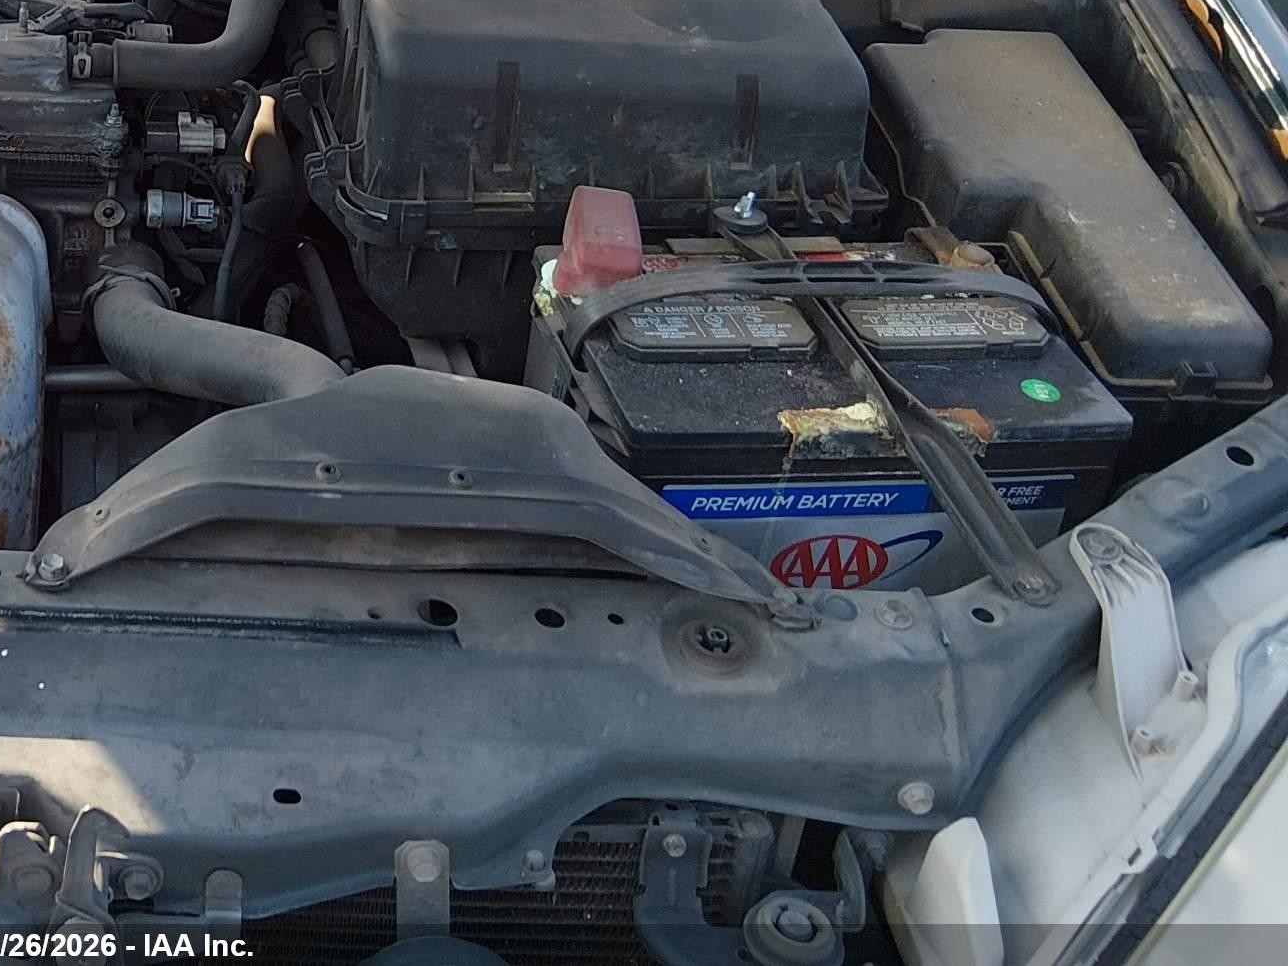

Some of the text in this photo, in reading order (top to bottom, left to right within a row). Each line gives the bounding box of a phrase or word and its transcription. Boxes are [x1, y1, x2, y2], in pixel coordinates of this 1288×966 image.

[654, 305, 704, 313] DANGER
[716, 305, 761, 313] POISON
[1007, 485, 1044, 498] FREE
[691, 492, 900, 512] PREMIUM BATTERY
[774, 536, 884, 589] AAA
